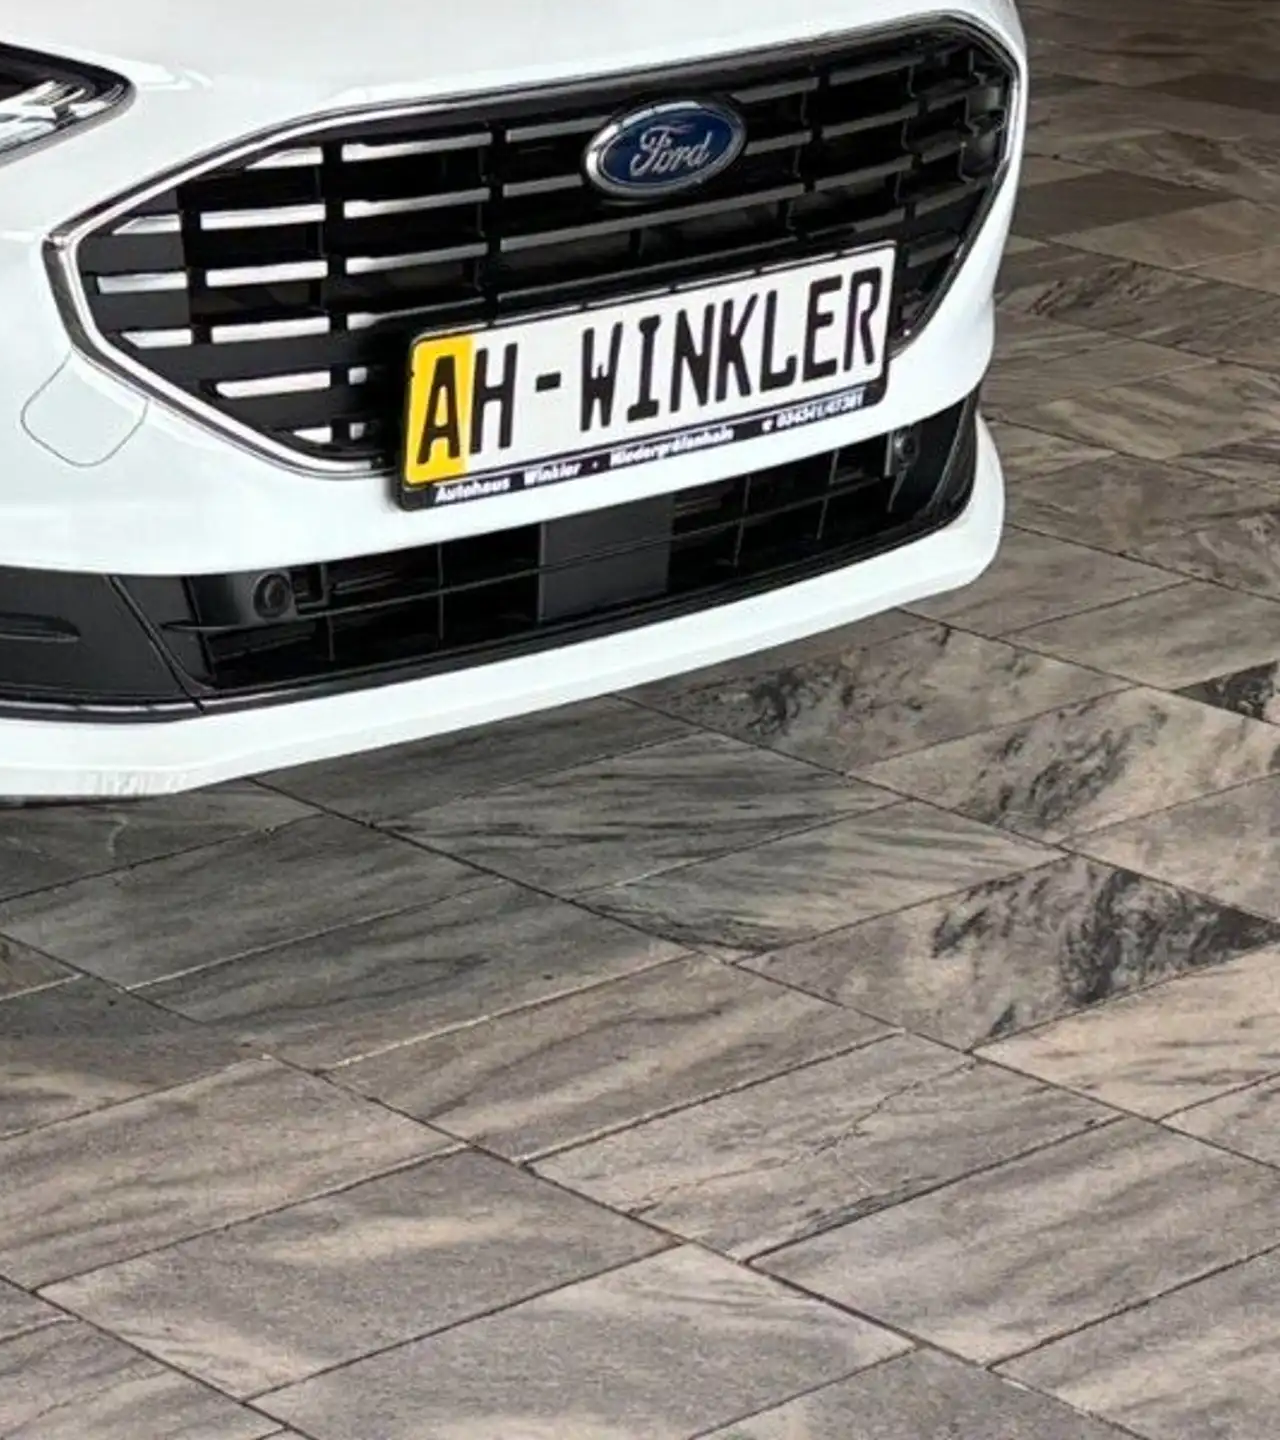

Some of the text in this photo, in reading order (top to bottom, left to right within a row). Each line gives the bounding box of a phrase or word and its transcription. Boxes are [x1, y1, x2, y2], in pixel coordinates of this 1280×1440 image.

[630, 121, 713, 177] Ford
[417, 267, 883, 464] AH-WINKLER
[434, 478, 511, 502] Autohaus
[523, 462, 582, 486] Winkler
